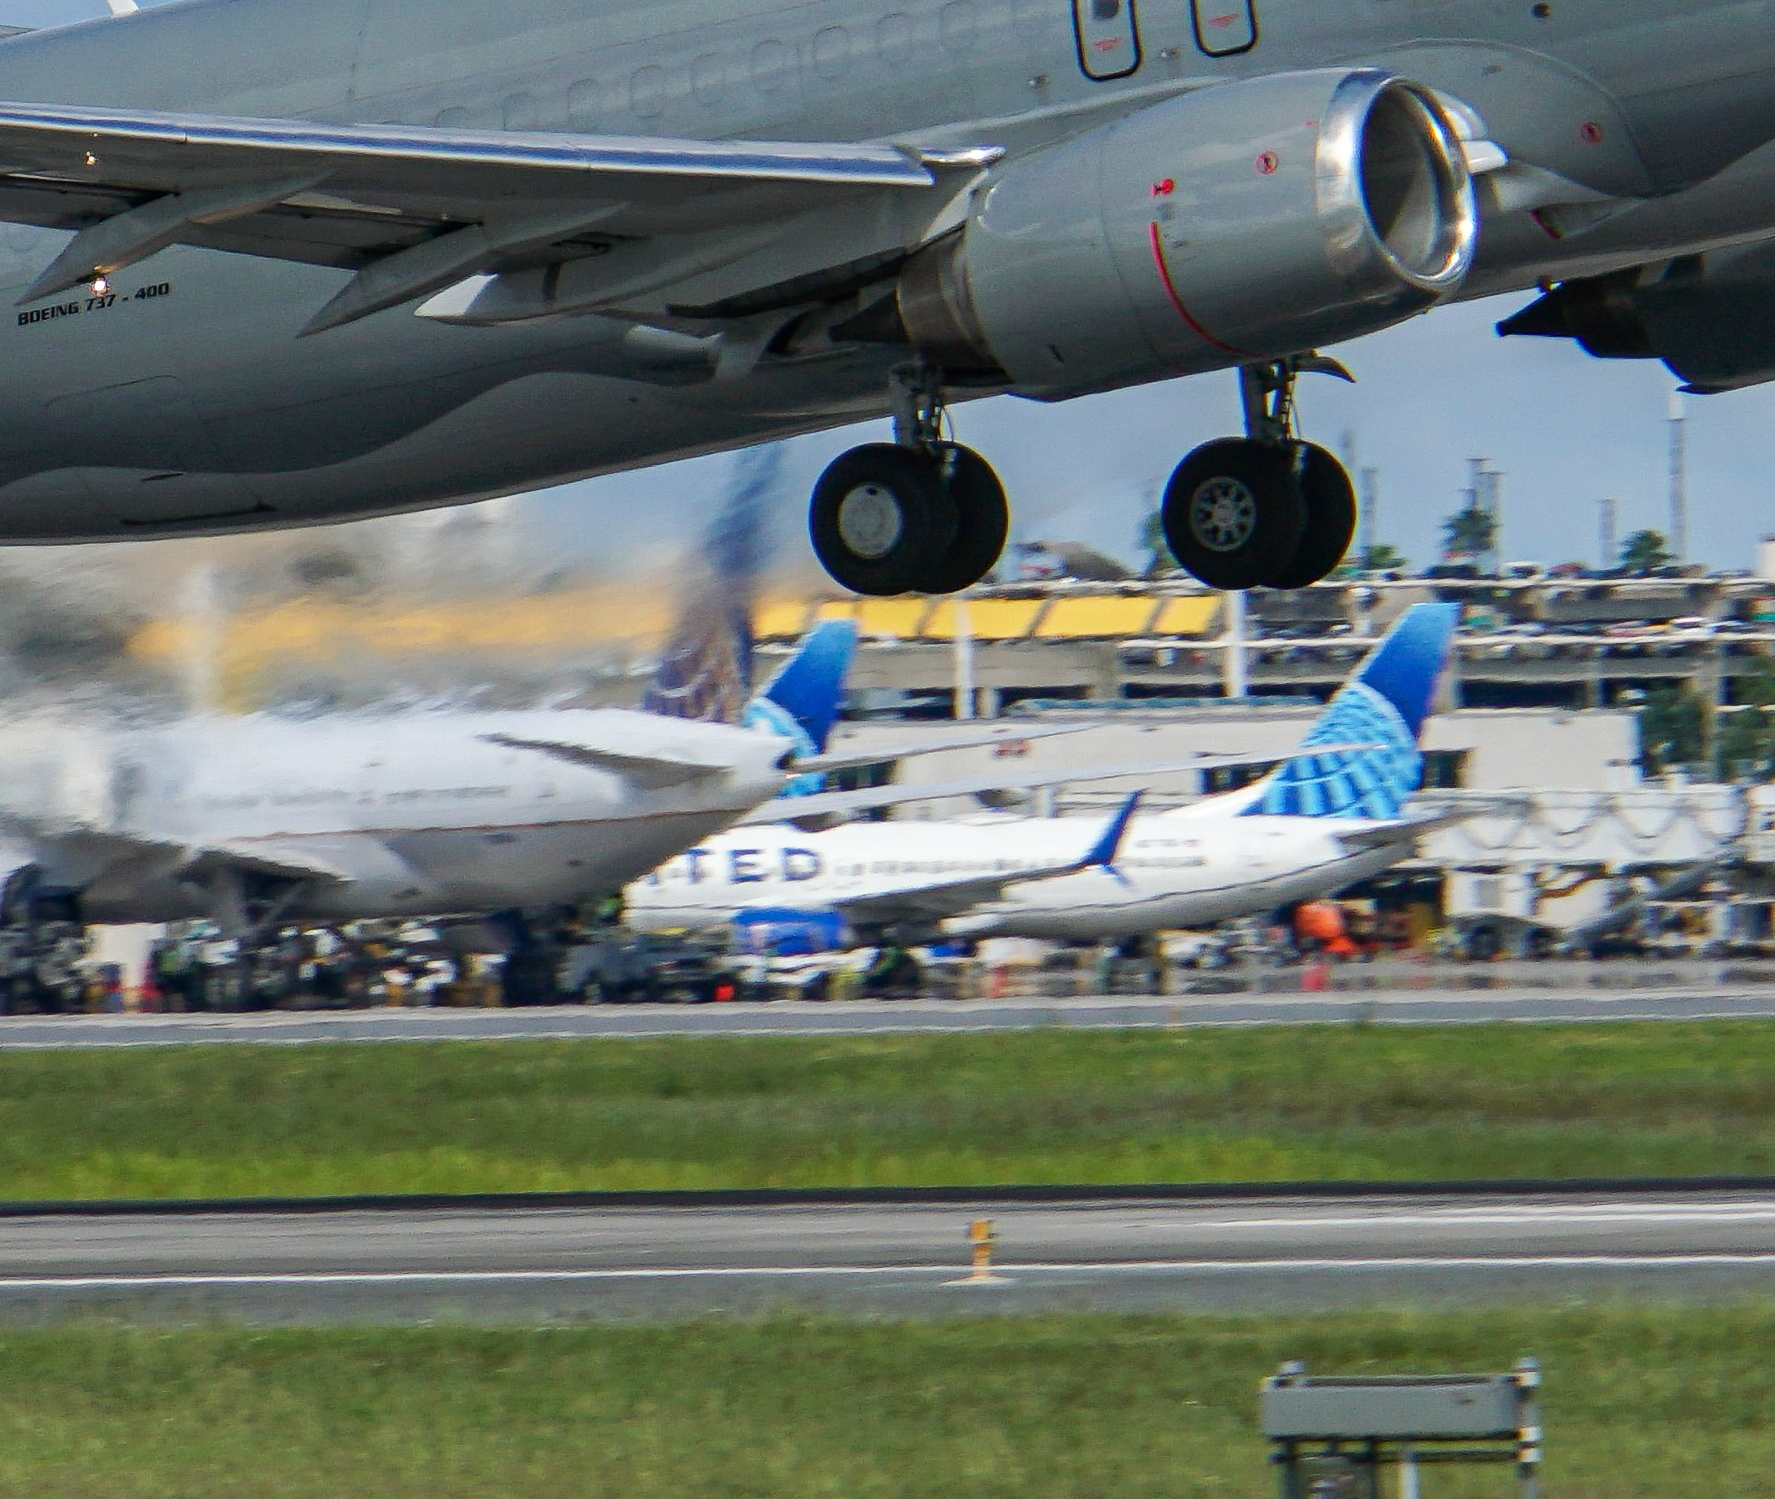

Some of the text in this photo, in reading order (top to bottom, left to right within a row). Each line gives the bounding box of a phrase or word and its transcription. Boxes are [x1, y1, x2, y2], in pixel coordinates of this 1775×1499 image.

[17, 300, 80, 327] BOEING
[84, 294, 116, 312] 737
[134, 282, 171, 300] 400
